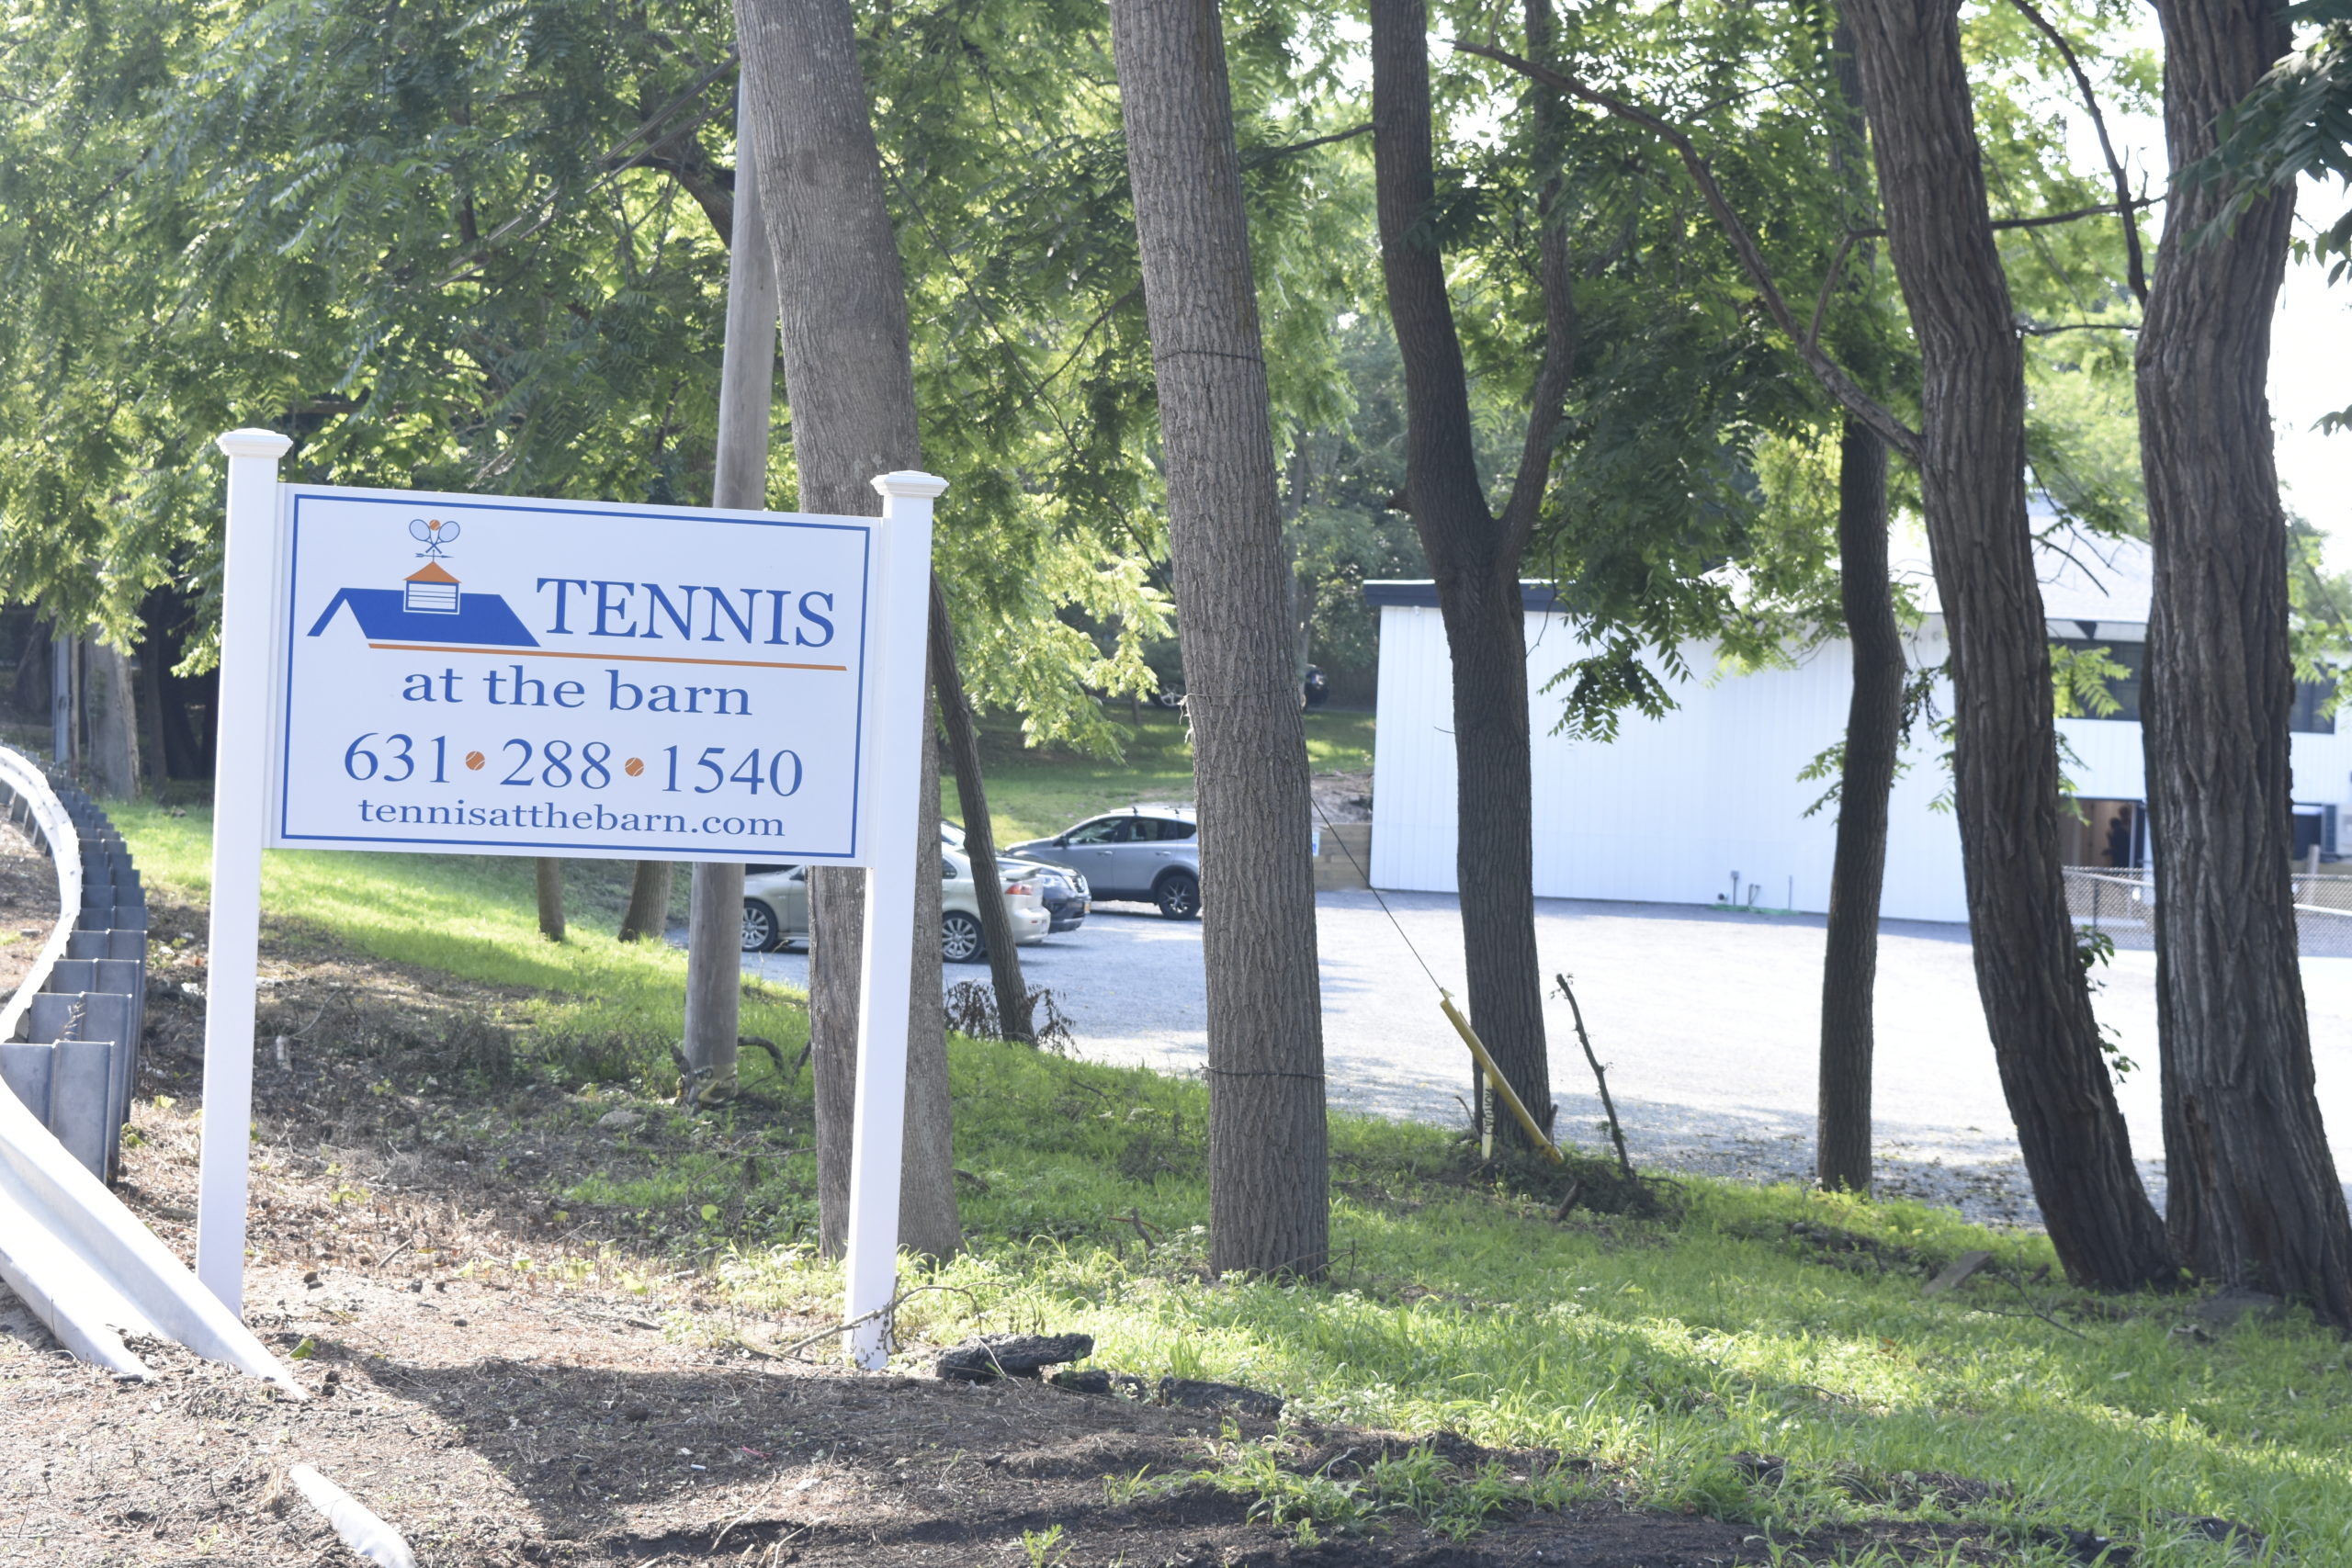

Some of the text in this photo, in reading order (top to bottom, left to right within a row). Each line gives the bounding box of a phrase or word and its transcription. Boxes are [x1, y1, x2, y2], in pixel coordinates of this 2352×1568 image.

[536, 576, 837, 648] TENNIS
[401, 663, 753, 716] at the barn
[344, 731, 804, 797] 631 288 1540
[358, 799, 786, 838] tennisatthebarn.com
